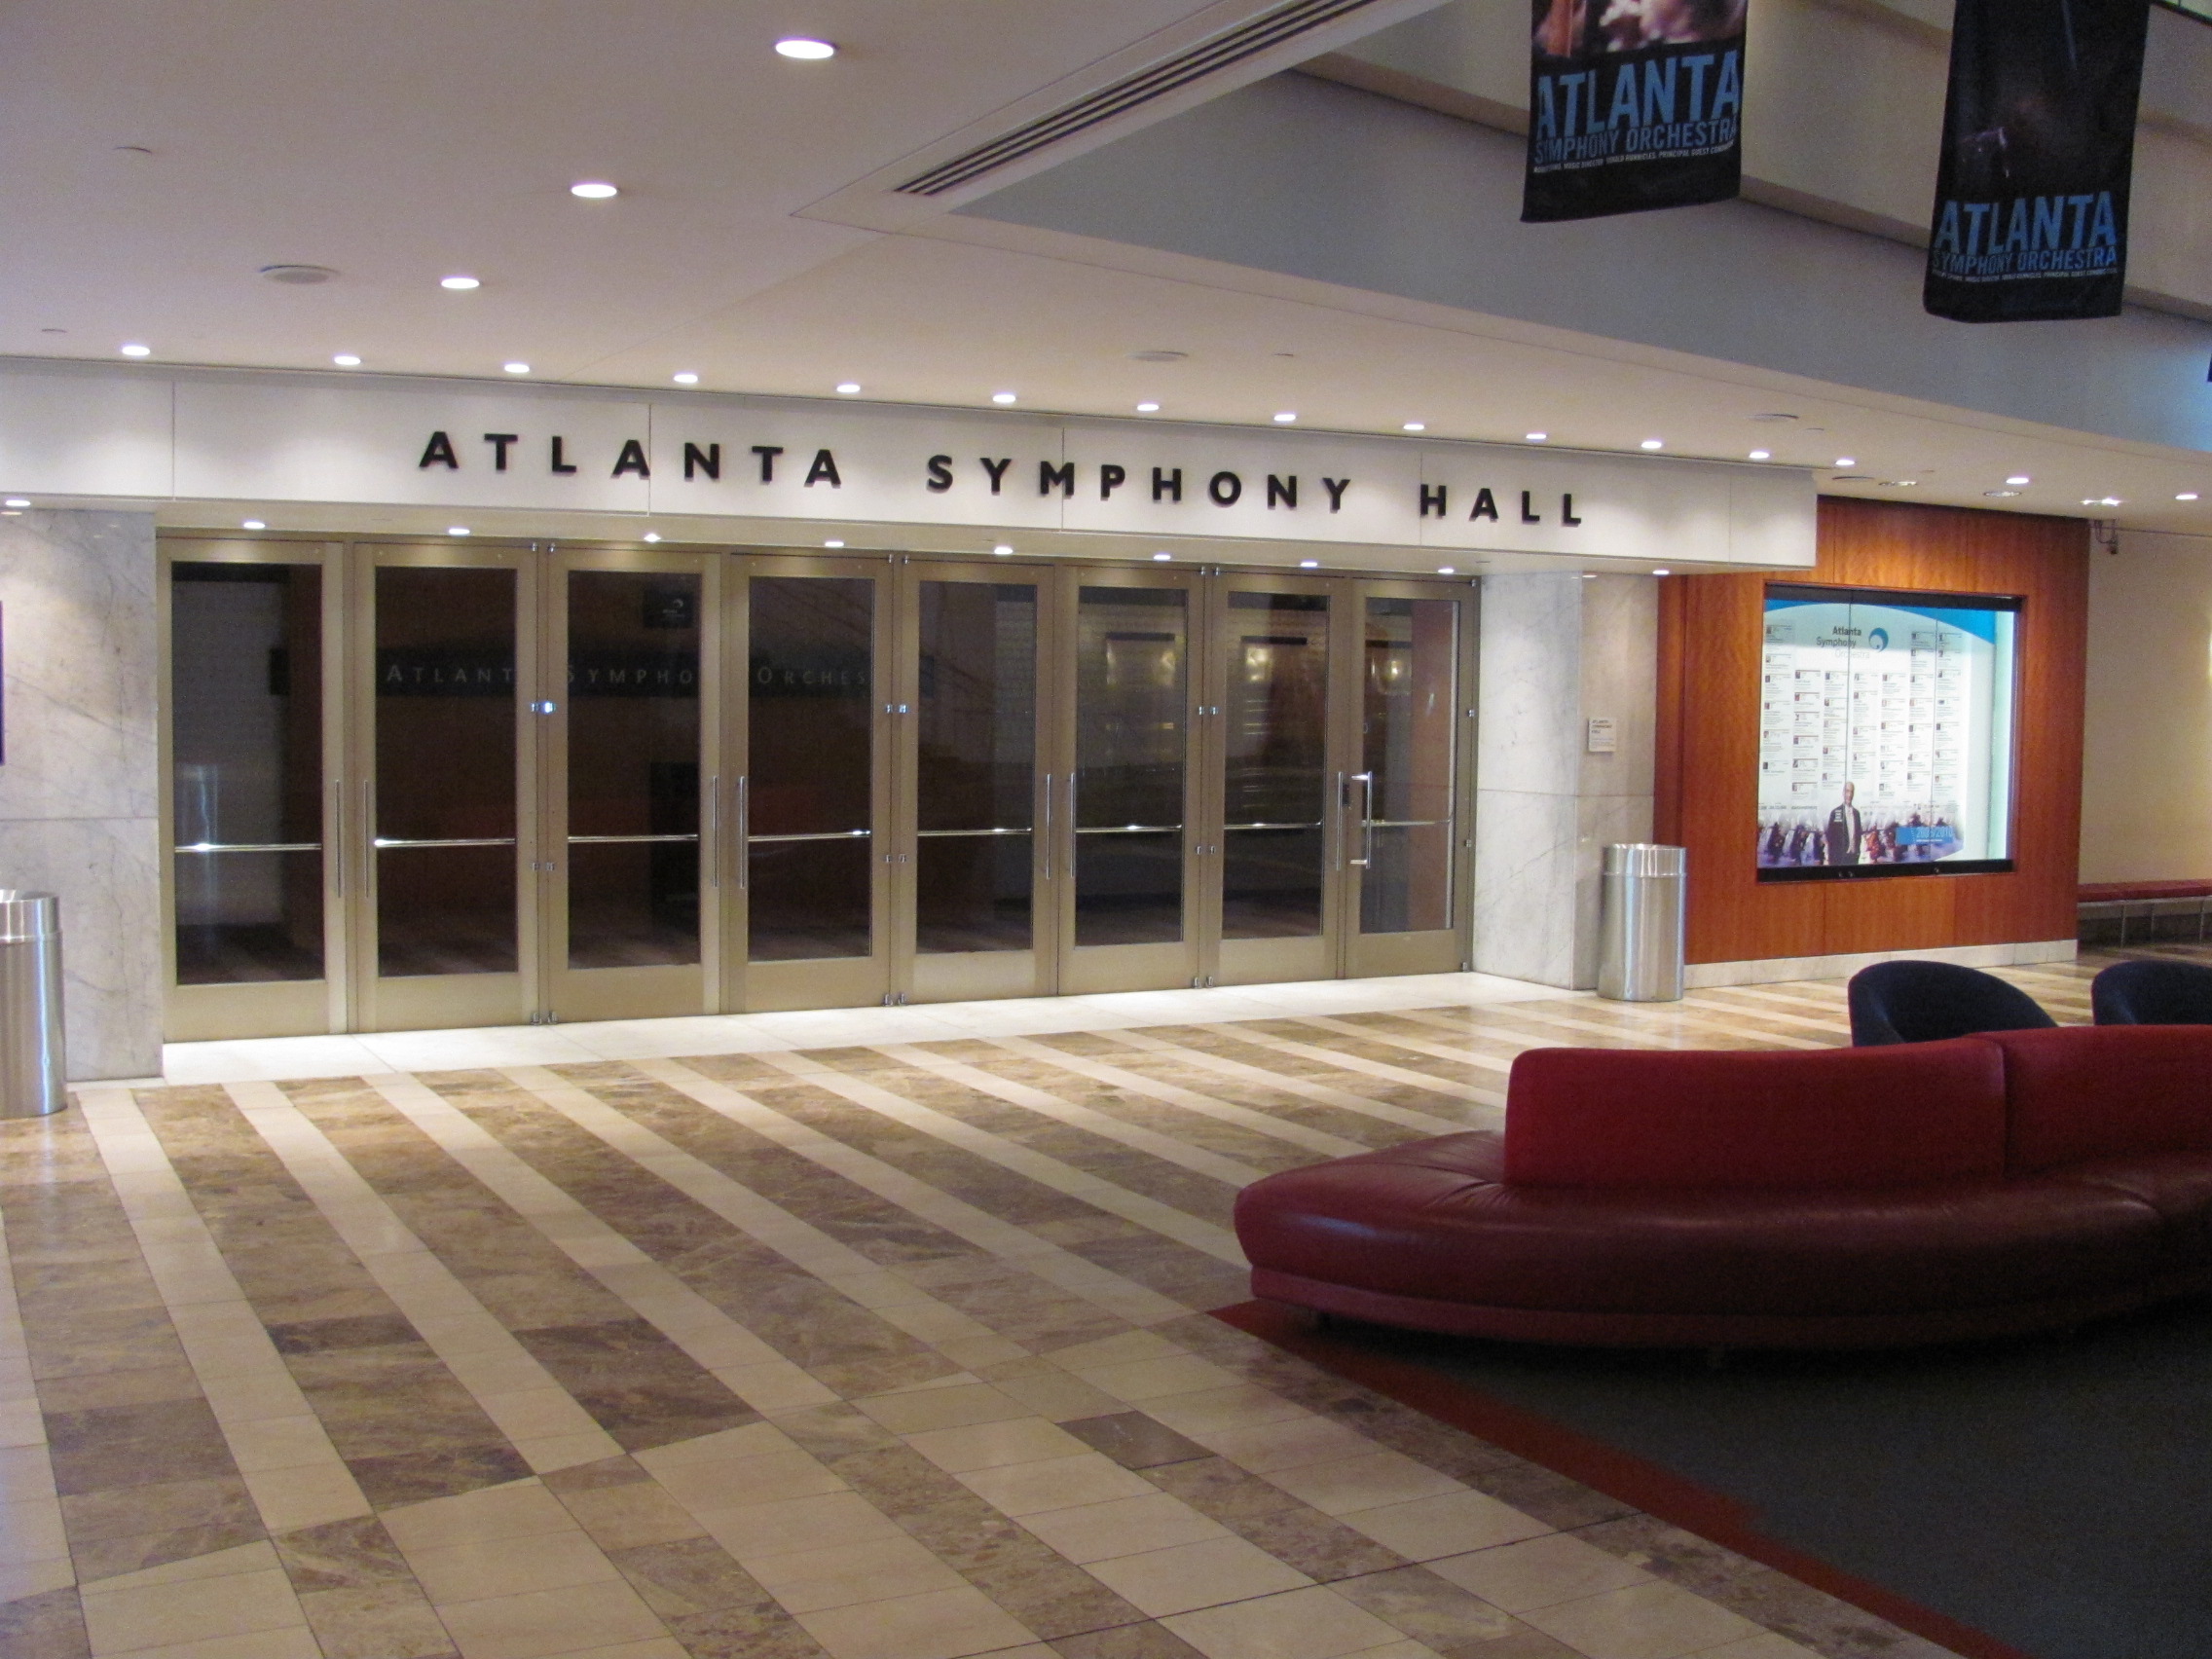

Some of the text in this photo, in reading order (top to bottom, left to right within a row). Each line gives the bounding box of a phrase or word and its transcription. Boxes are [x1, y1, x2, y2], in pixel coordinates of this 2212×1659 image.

[1536, 50, 1740, 141] ATLANTA
[1625, 115, 1737, 152] ORCHESTRA
[1935, 191, 2118, 256] ATLANTA
[1932, 244, 2118, 275] SYMPHONY ORCHESTRA
[420, 431, 1582, 525] ATLANTA SYMPHONY HALL
[1816, 637, 1857, 649] Symphony
[1832, 626, 1862, 636] Atlanta
[387, 665, 866, 685] ATLANT SYMPHO ORCHES
